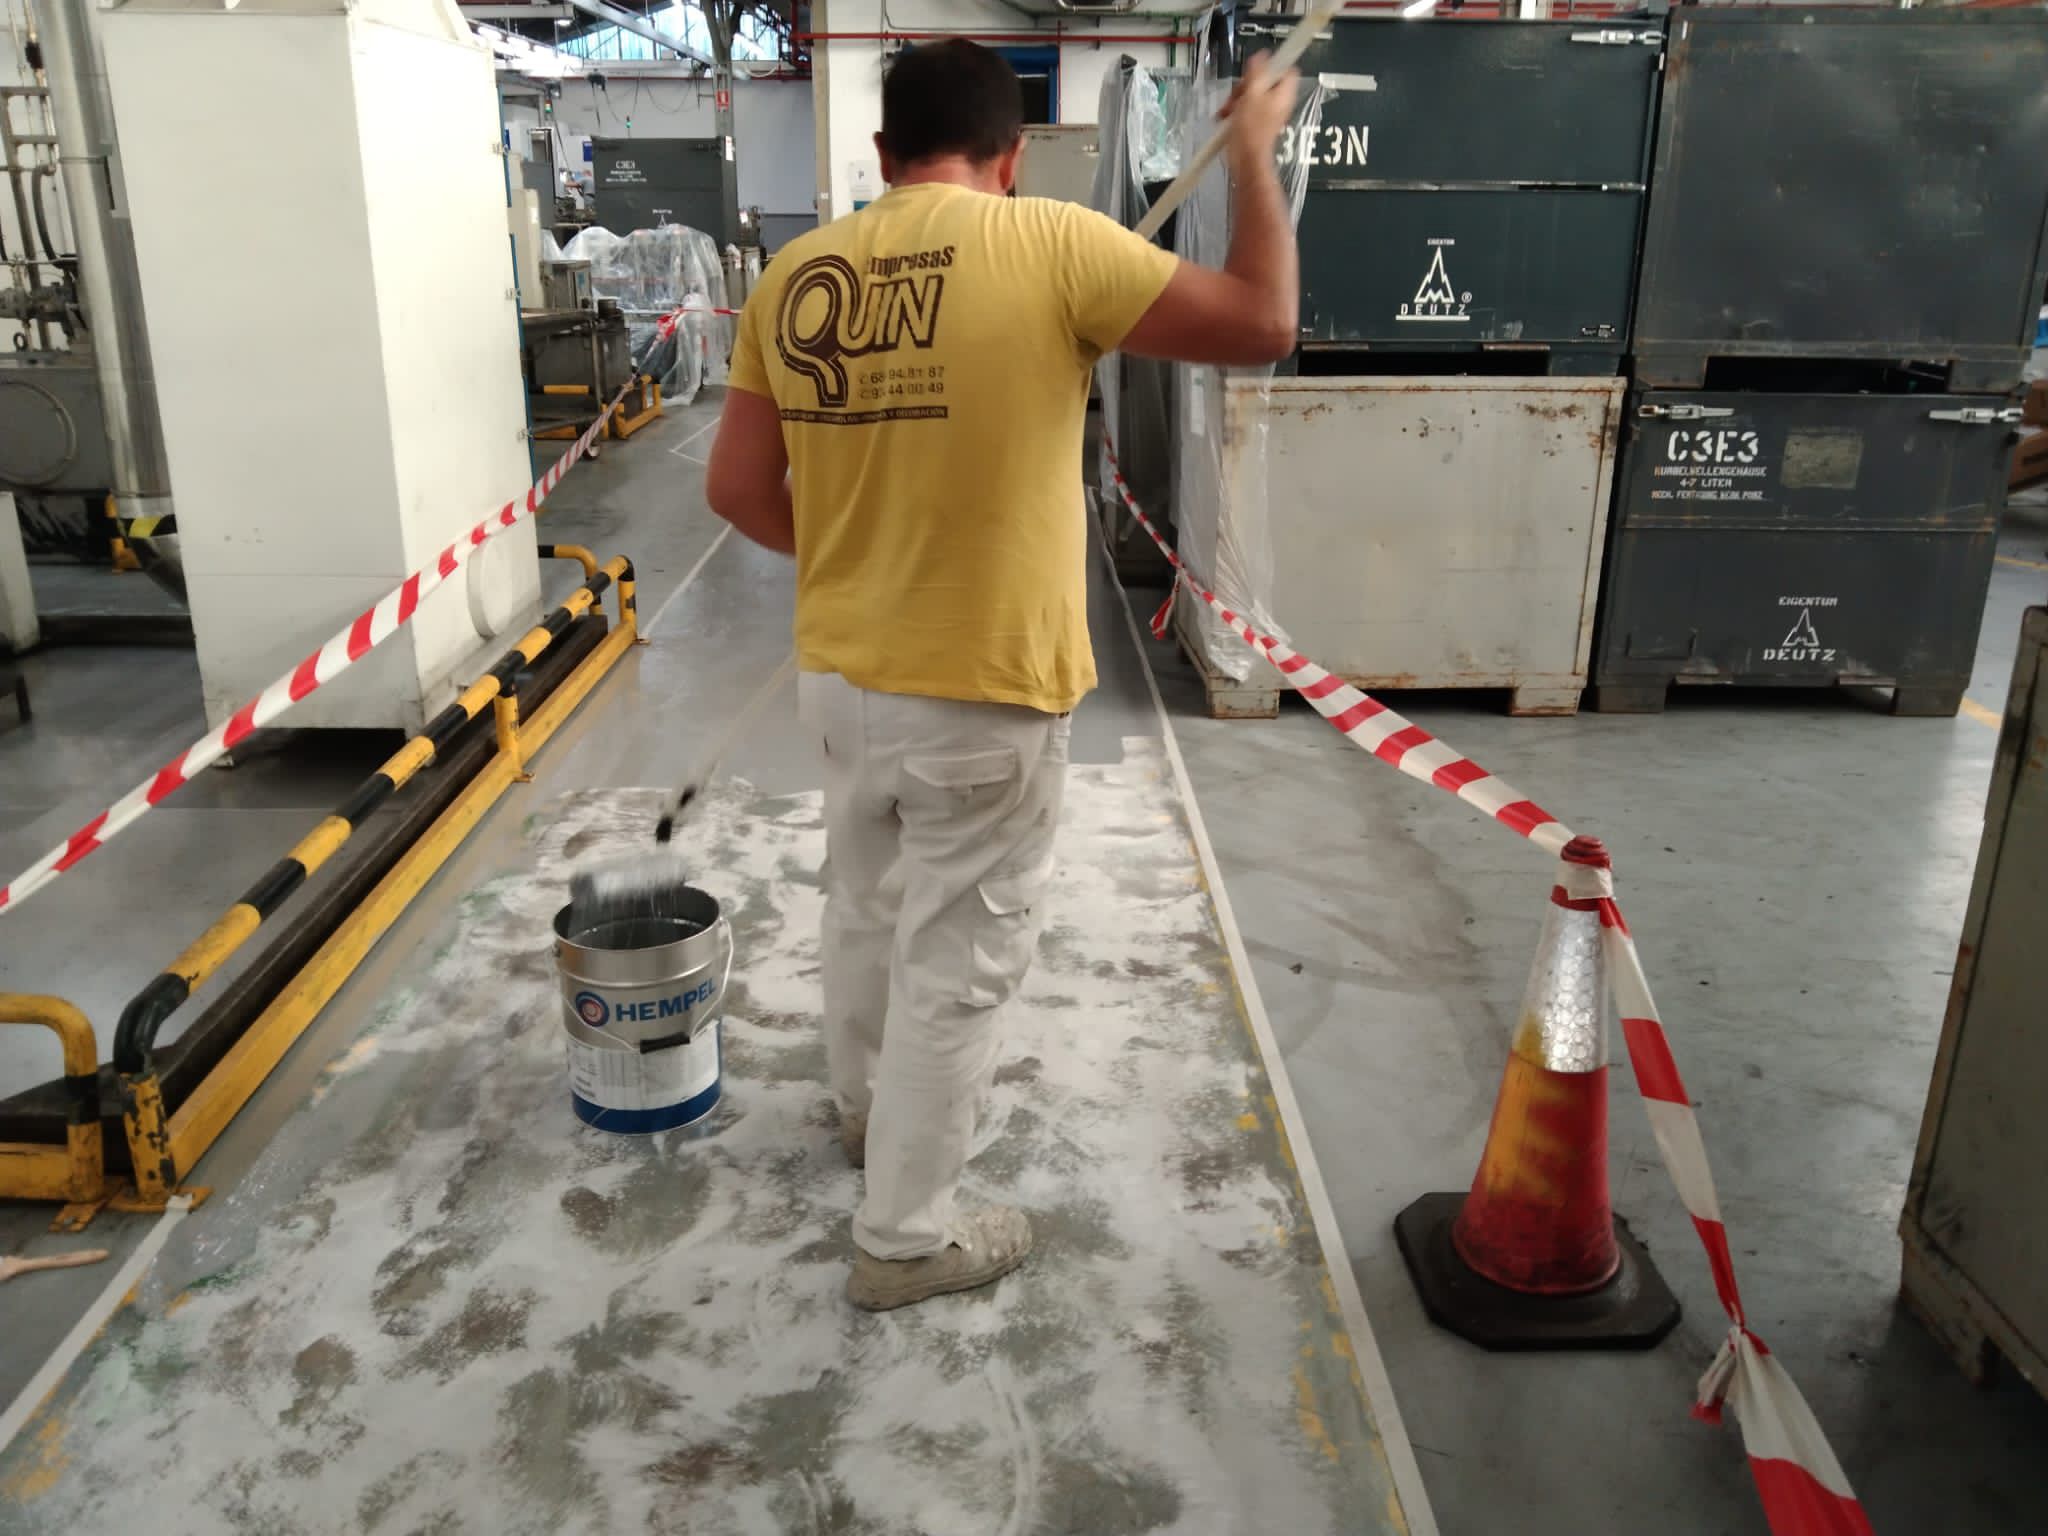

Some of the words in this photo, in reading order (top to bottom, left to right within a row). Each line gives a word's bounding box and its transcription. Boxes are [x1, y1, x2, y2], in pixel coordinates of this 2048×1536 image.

[1401, 303, 1466, 316] DEUTZ
[776, 254, 945, 408] QUIN
[1667, 430, 1759, 463] C3E3
[1762, 648, 1837, 661] DEUTZ
[615, 978, 716, 1022] HEMPEL
